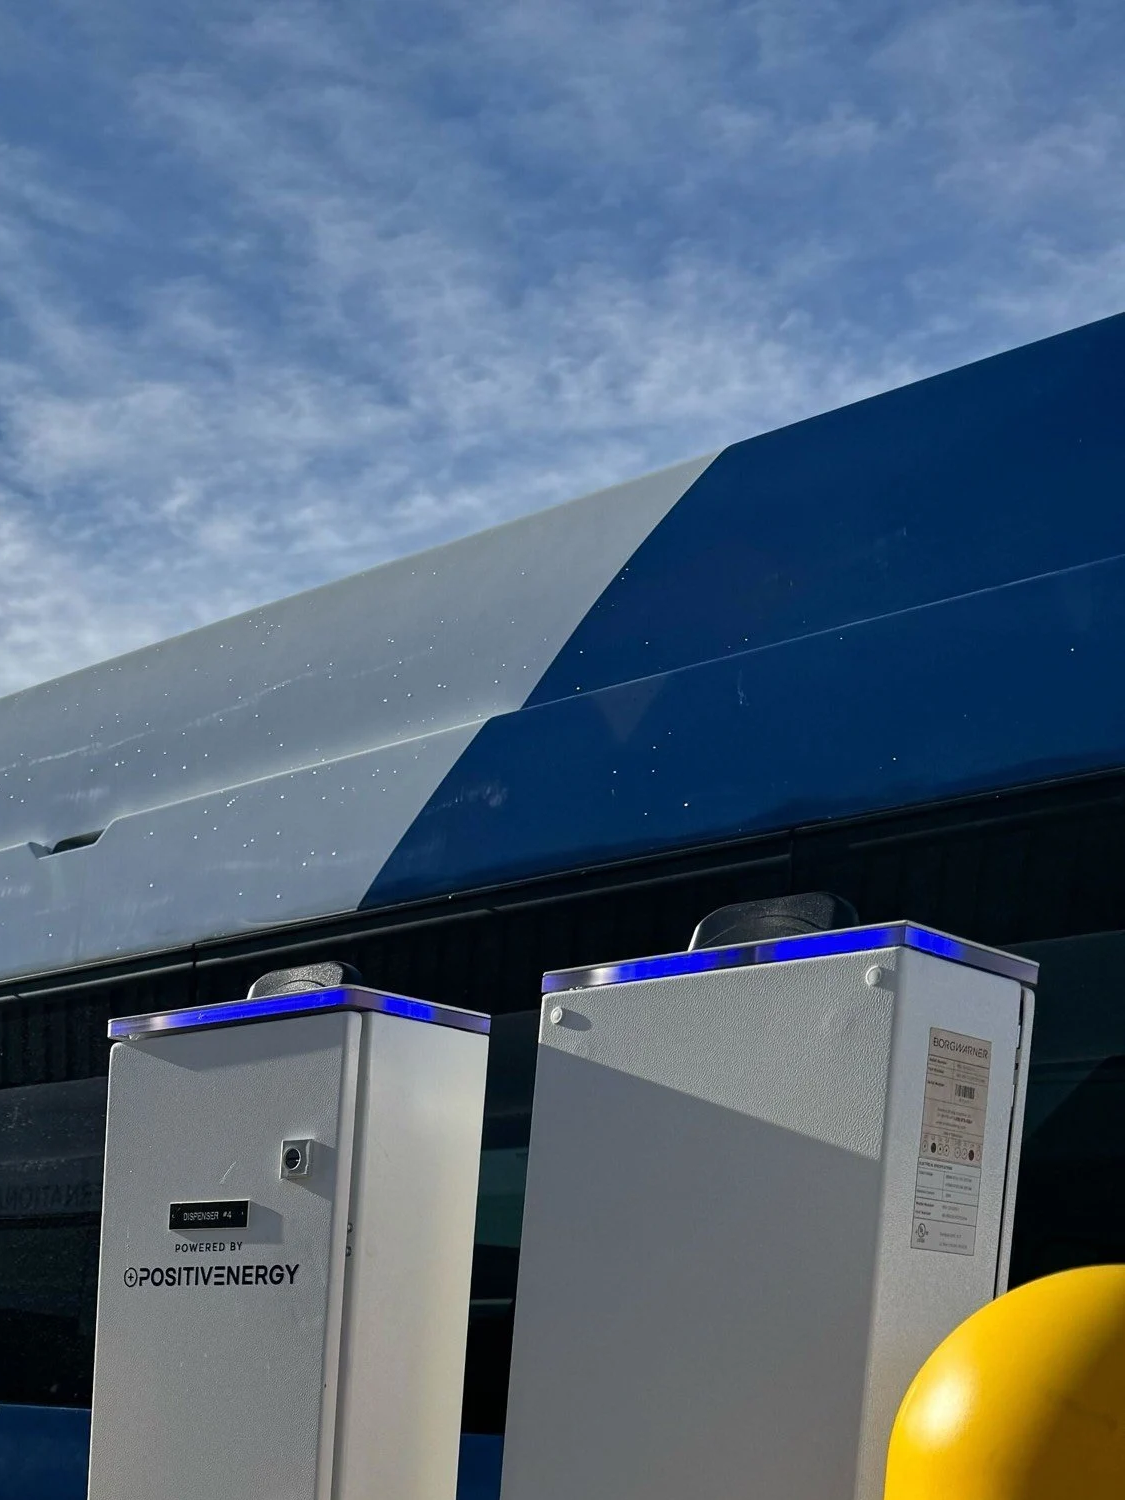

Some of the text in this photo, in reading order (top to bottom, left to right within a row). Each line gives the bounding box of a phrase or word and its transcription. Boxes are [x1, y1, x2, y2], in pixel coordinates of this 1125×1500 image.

[933, 1037, 989, 1060] BORGWARNER
[183, 1211, 232, 1221] DISPENSER #4
[175, 1241, 243, 1252] POWERED BY
[138, 1264, 300, 1287] POSITIVENERGY
